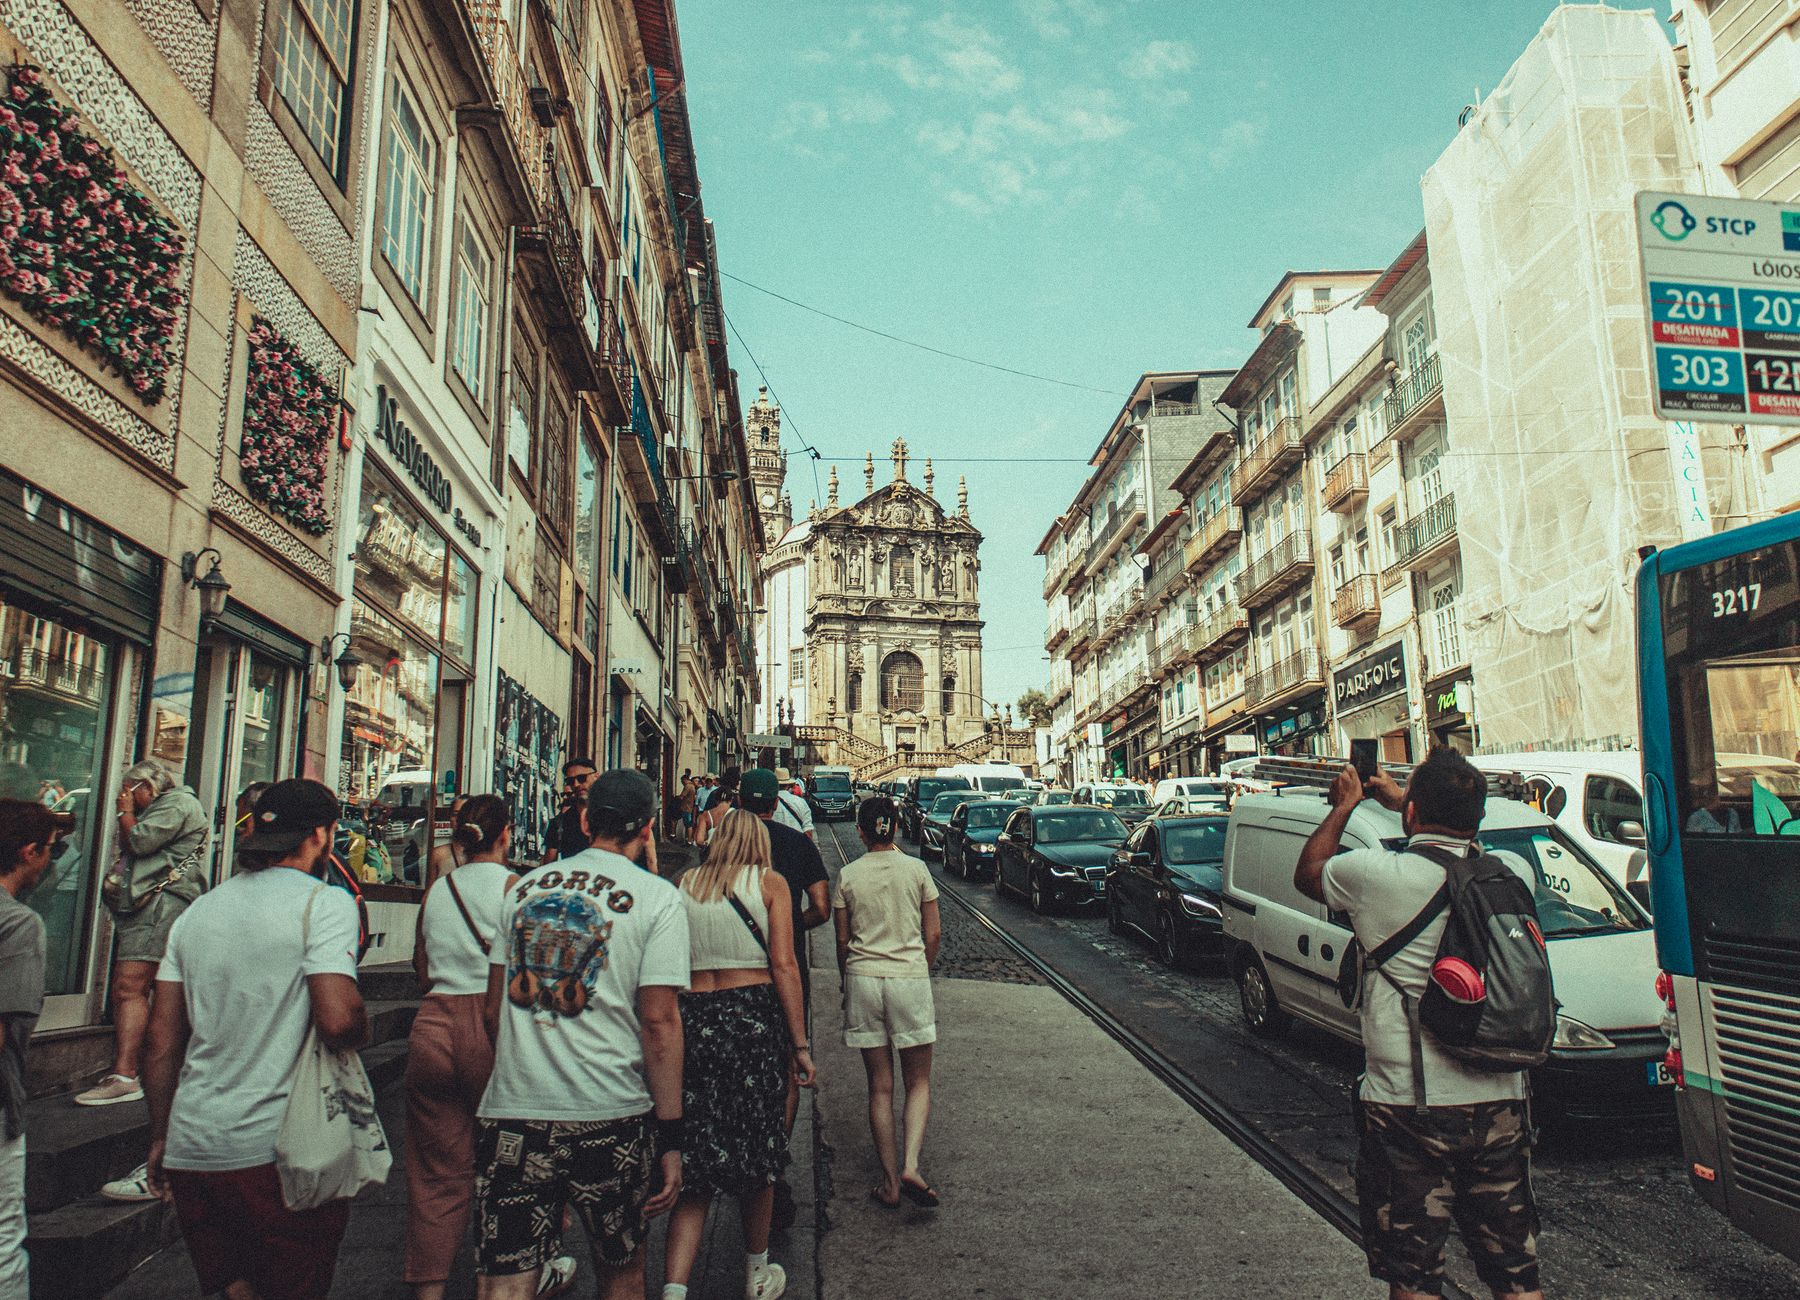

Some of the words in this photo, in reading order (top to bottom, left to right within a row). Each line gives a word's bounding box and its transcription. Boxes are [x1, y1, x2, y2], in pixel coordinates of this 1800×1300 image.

[1706, 217, 1756, 235] STCP
[1665, 289, 1723, 322] 201
[1662, 323, 1729, 339] DESATIVADA
[1671, 355, 1730, 387] 303
[1712, 584, 1761, 618] 3217
[1337, 656, 1401, 702] PARFOIS
[516, 871, 634, 914] PORTO
